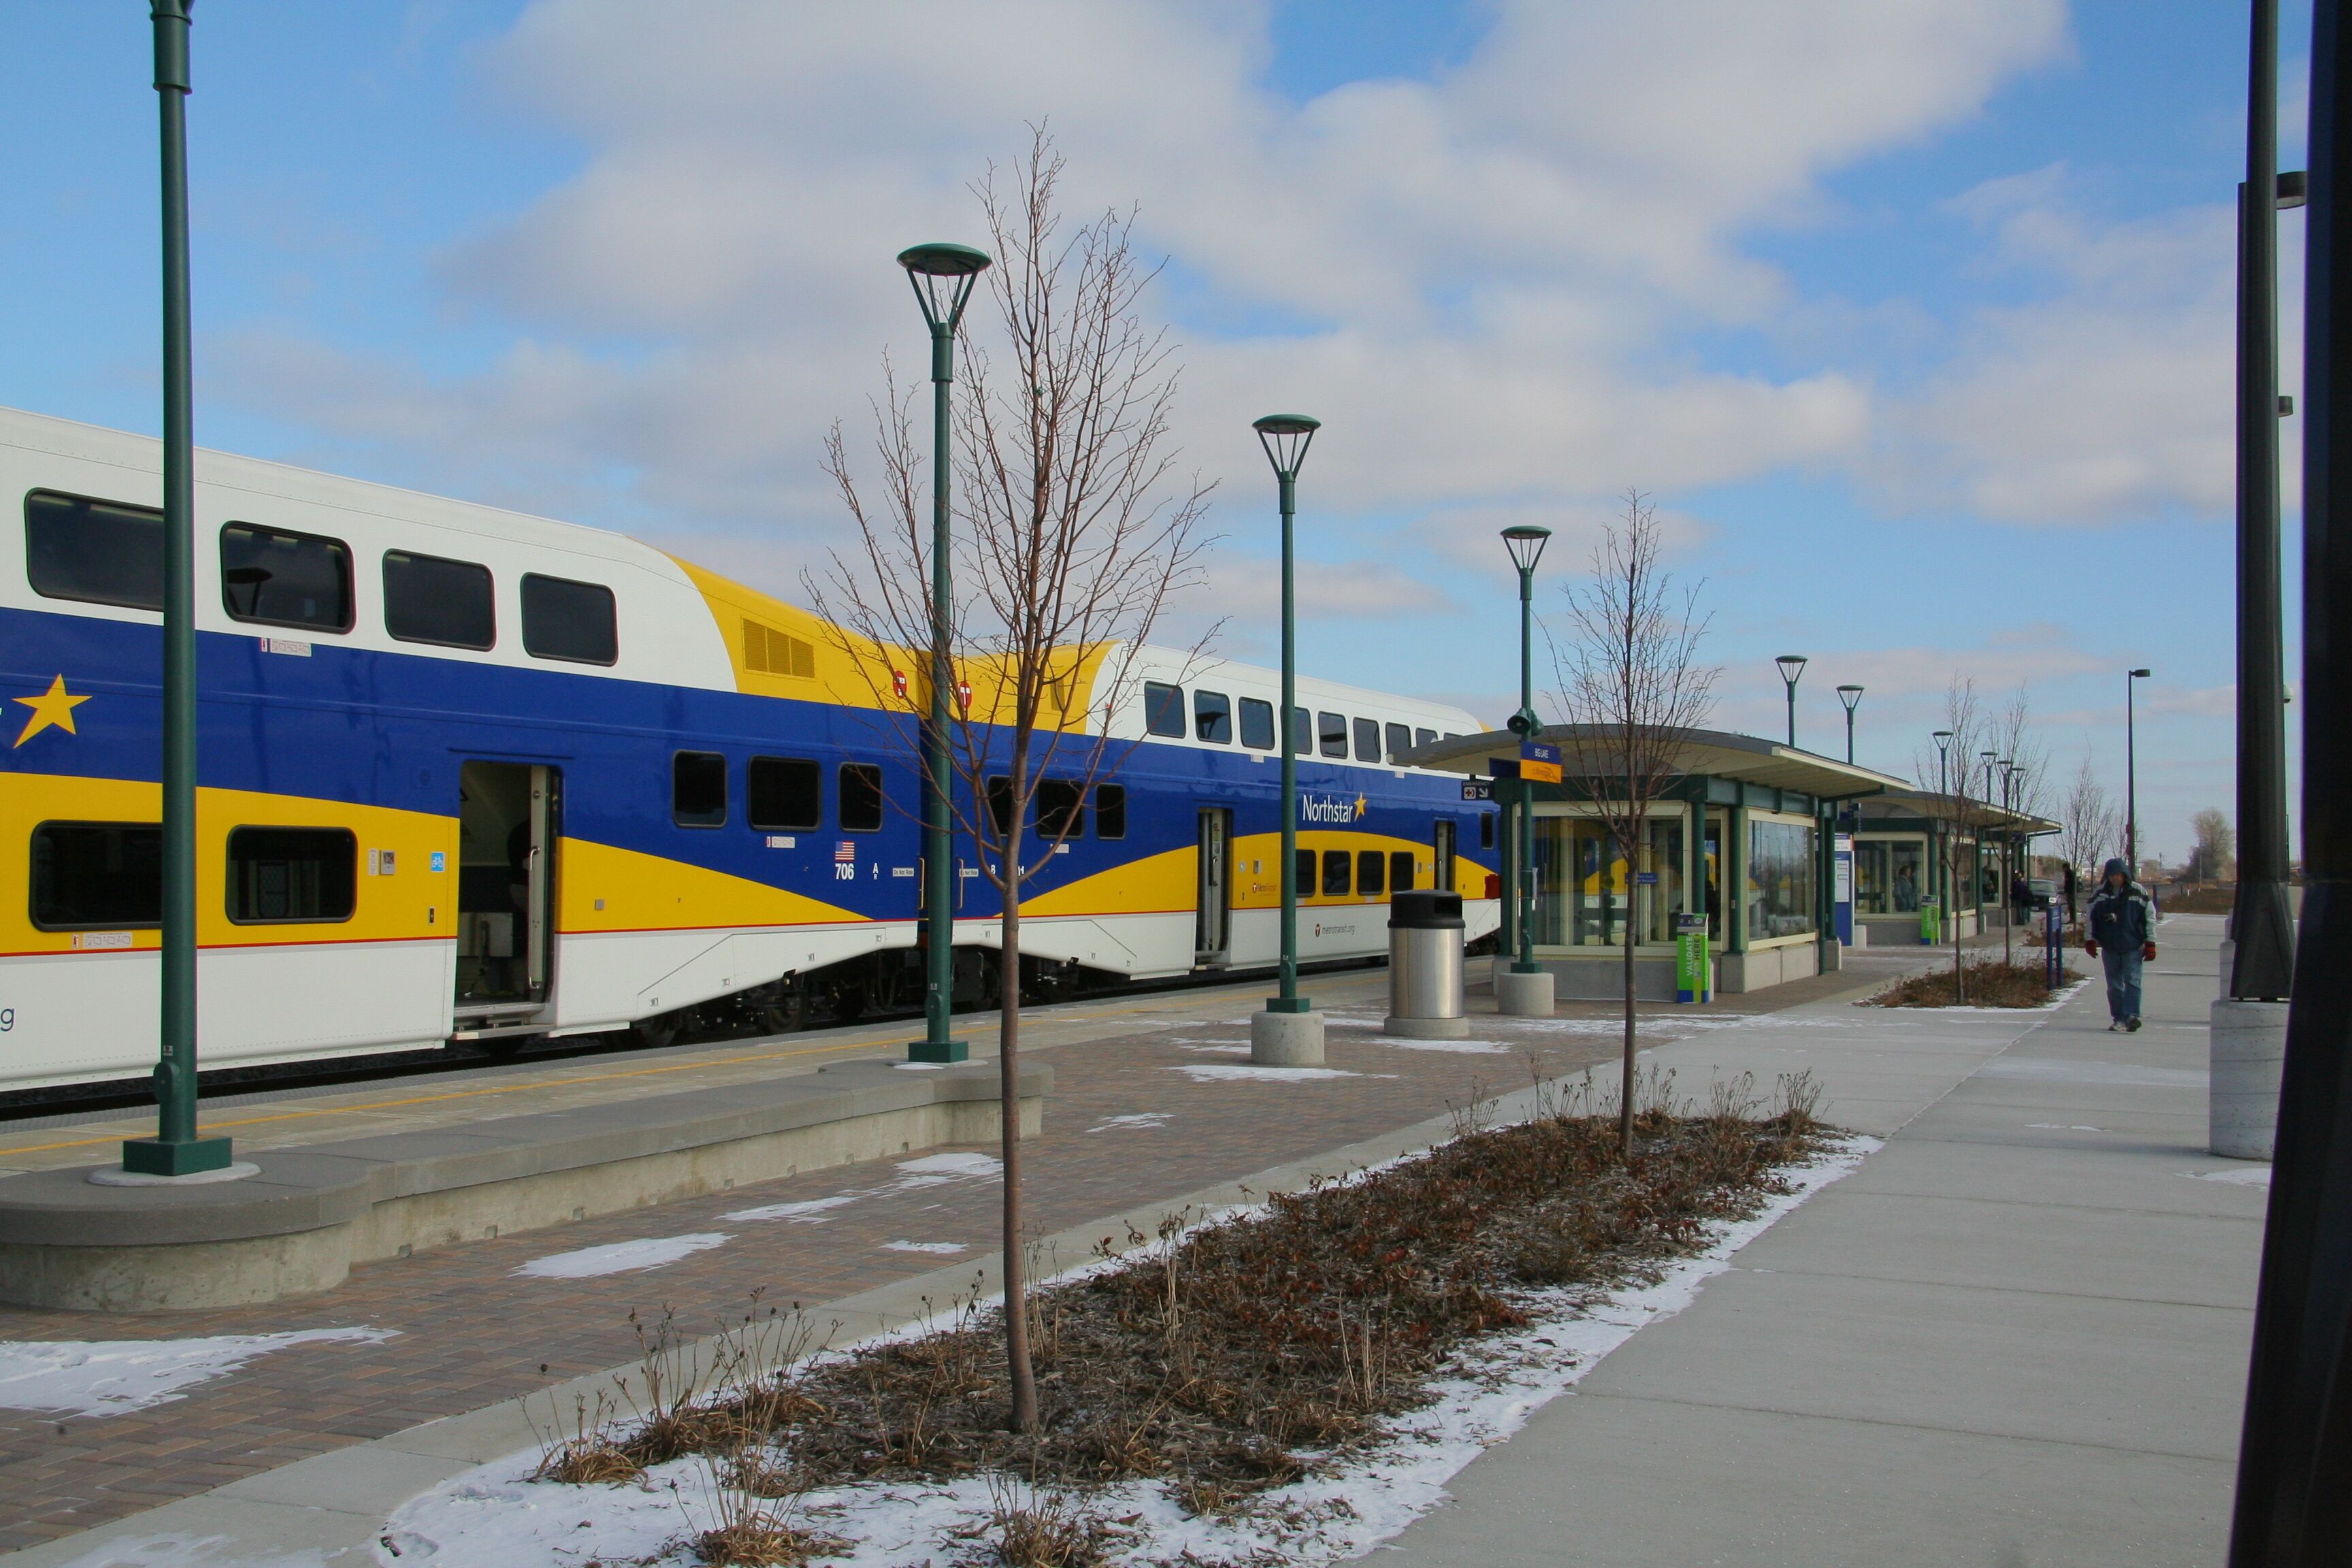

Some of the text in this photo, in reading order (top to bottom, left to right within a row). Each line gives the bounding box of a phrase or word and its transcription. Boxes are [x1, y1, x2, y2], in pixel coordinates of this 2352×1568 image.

[1303, 794, 1353, 823] Northstar
[835, 863, 855, 880] 706
[872, 862, 879, 874] A
[1322, 924, 1355, 935] metrotransit.org
